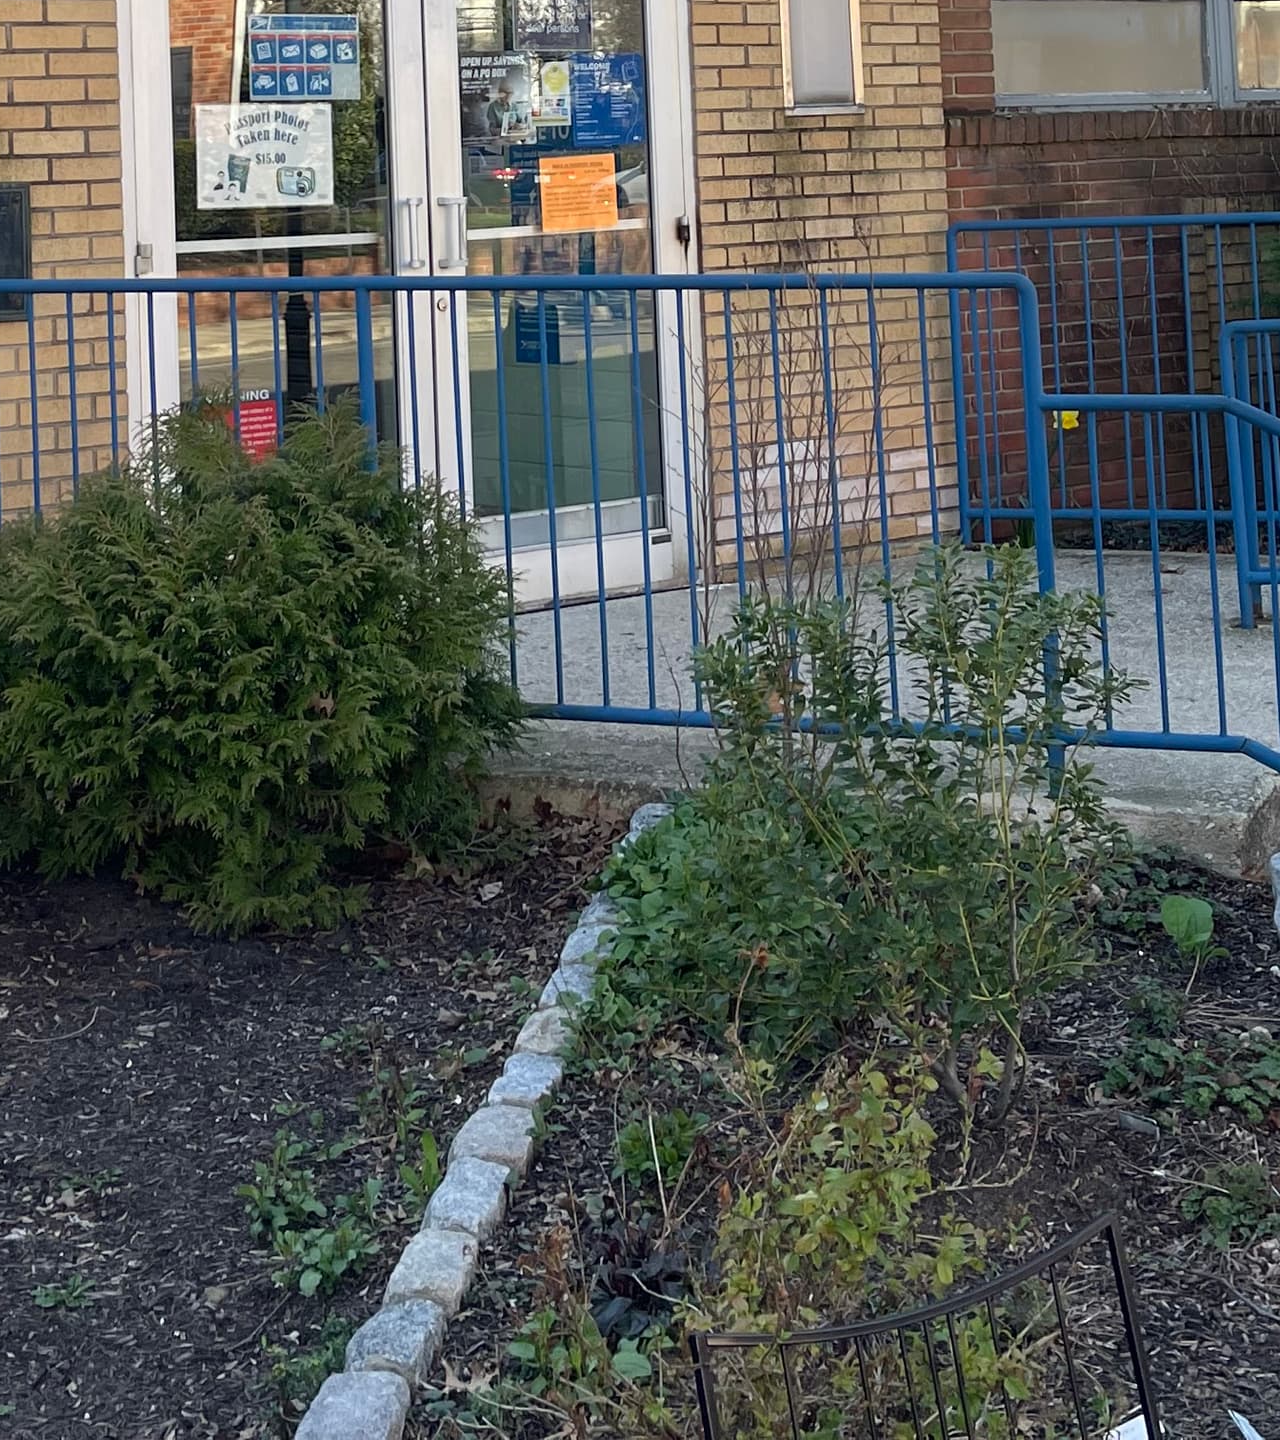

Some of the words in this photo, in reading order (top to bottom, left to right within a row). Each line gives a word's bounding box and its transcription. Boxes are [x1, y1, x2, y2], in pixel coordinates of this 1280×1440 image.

[460, 56, 481, 67] OPEN
[480, 68, 490, 78] PO
[274, 110, 310, 132] Photos
[236, 128, 270, 148] Taken
[274, 127, 299, 145] here
[255, 152, 287, 165] $15.00
